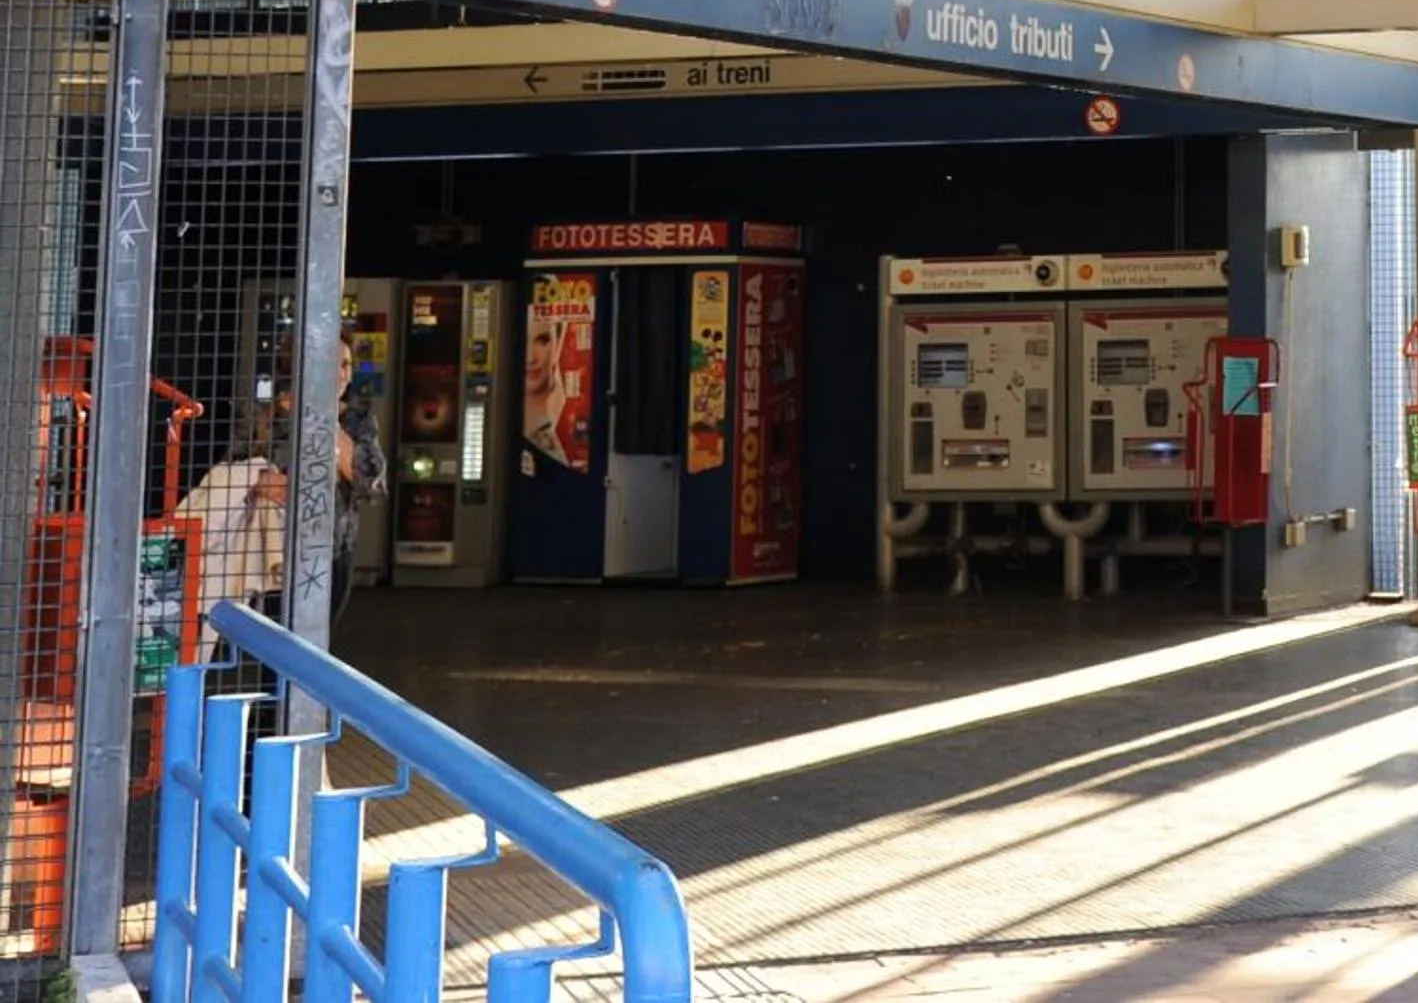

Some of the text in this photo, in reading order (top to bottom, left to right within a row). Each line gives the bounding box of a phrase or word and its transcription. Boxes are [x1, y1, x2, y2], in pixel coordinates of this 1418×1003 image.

[926, 0, 1074, 64] ufficio tributi
[686, 59, 771, 87] ai treni
[538, 223, 716, 249] FOTOTESSERA
[738, 272, 764, 536] FOTOTESSERA
